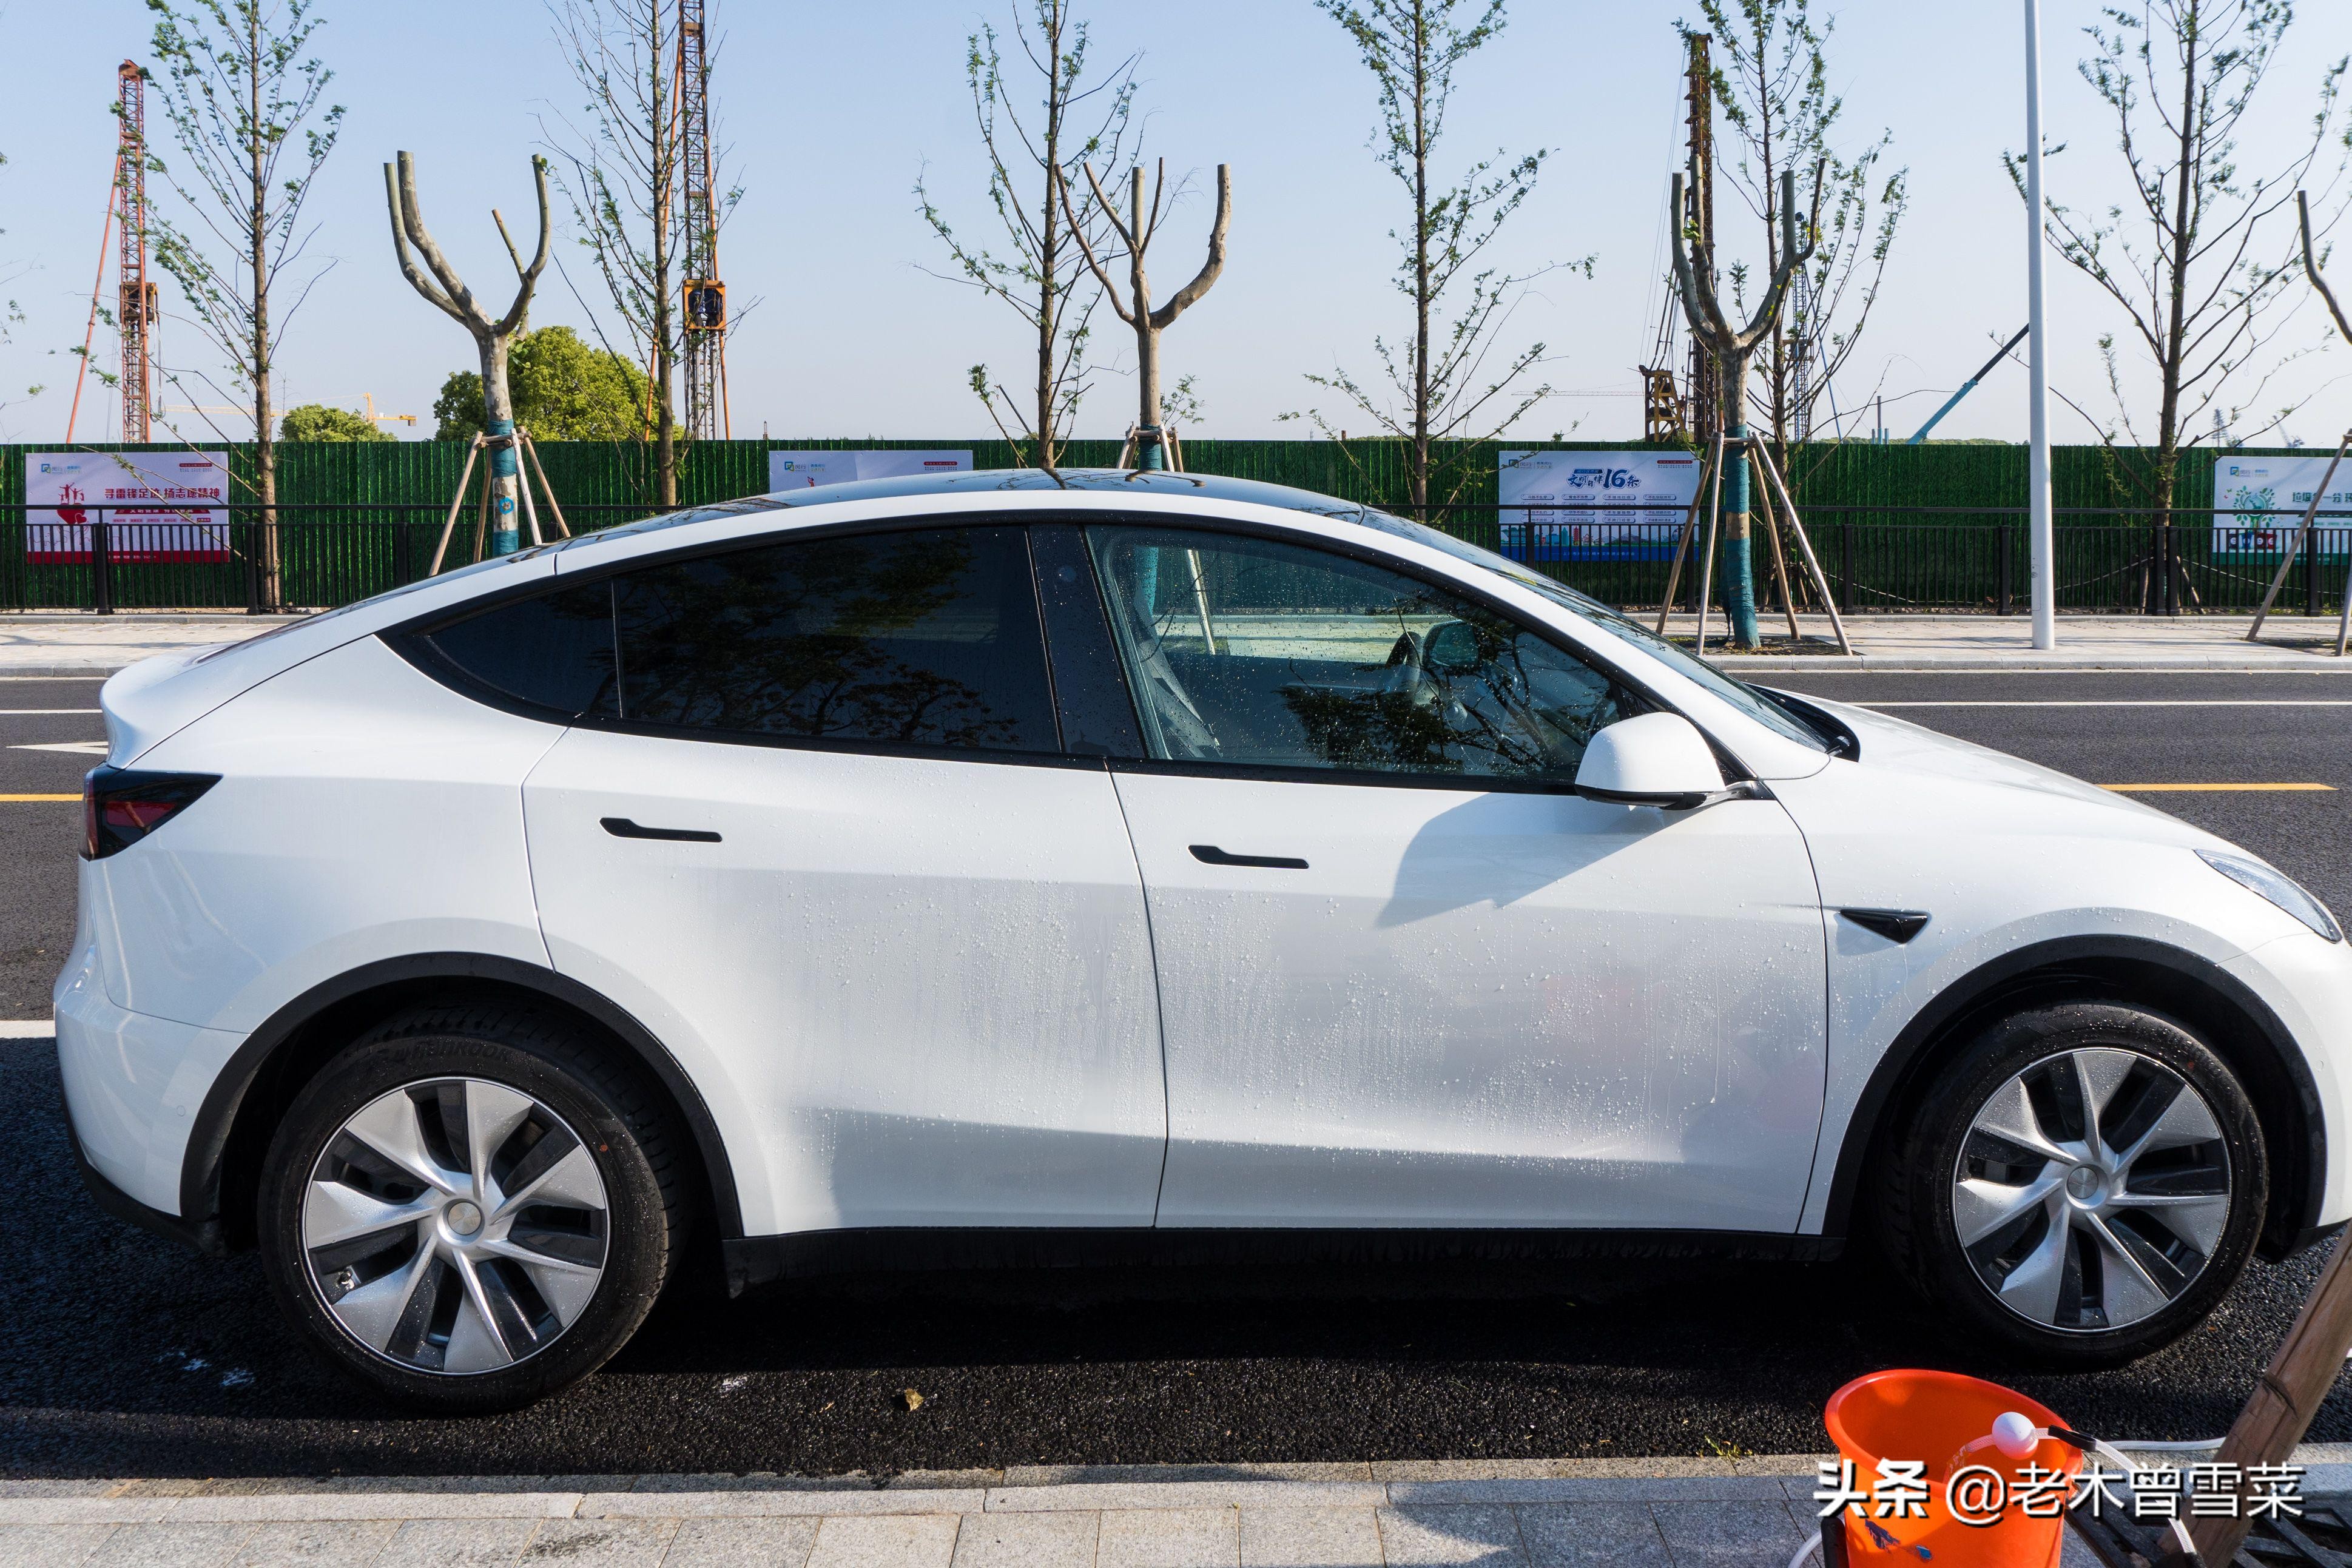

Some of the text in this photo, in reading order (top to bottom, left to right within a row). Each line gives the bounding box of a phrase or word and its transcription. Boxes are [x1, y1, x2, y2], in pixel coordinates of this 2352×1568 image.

[105, 487, 220, 499] 寻雷锋足迹 扬志愿精神
[2292, 492, 2342, 503] 垃圾一分
